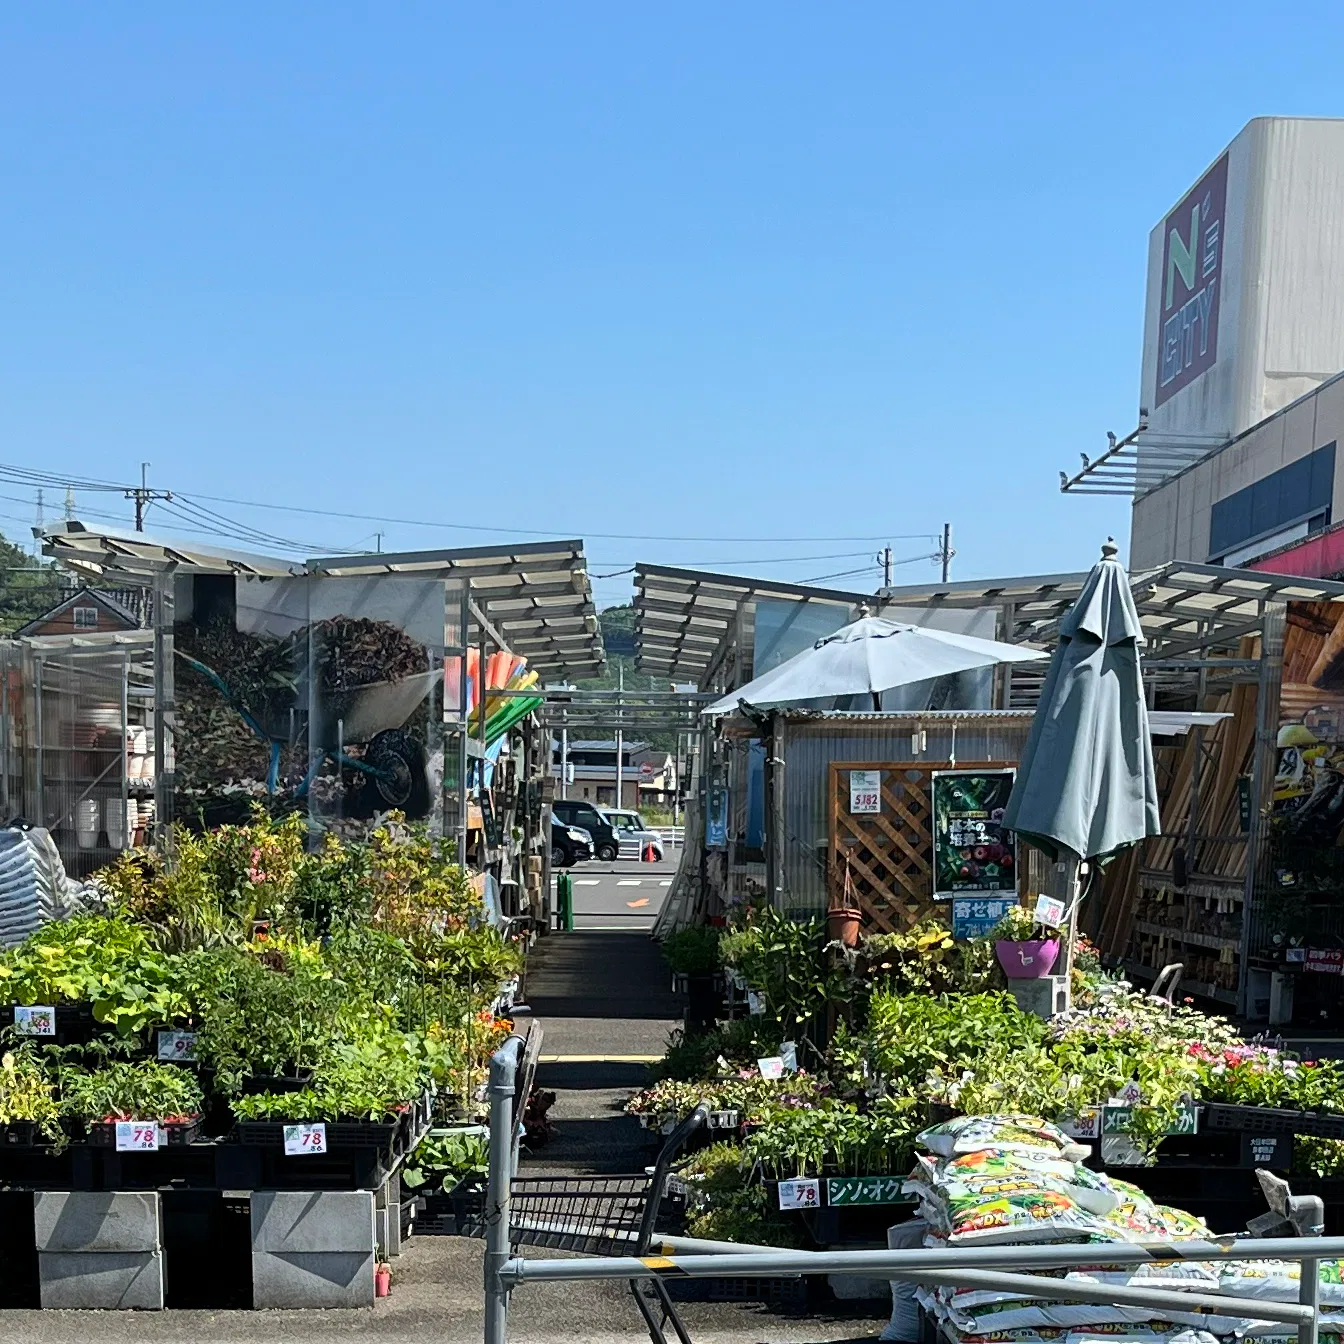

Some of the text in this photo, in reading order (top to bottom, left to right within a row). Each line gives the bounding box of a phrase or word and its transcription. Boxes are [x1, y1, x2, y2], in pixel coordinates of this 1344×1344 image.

[1160, 277, 1217, 388] CITY
[133, 1129, 155, 1143] 78
[302, 1132, 322, 1145] 78
[795, 1186, 816, 1202] 78
